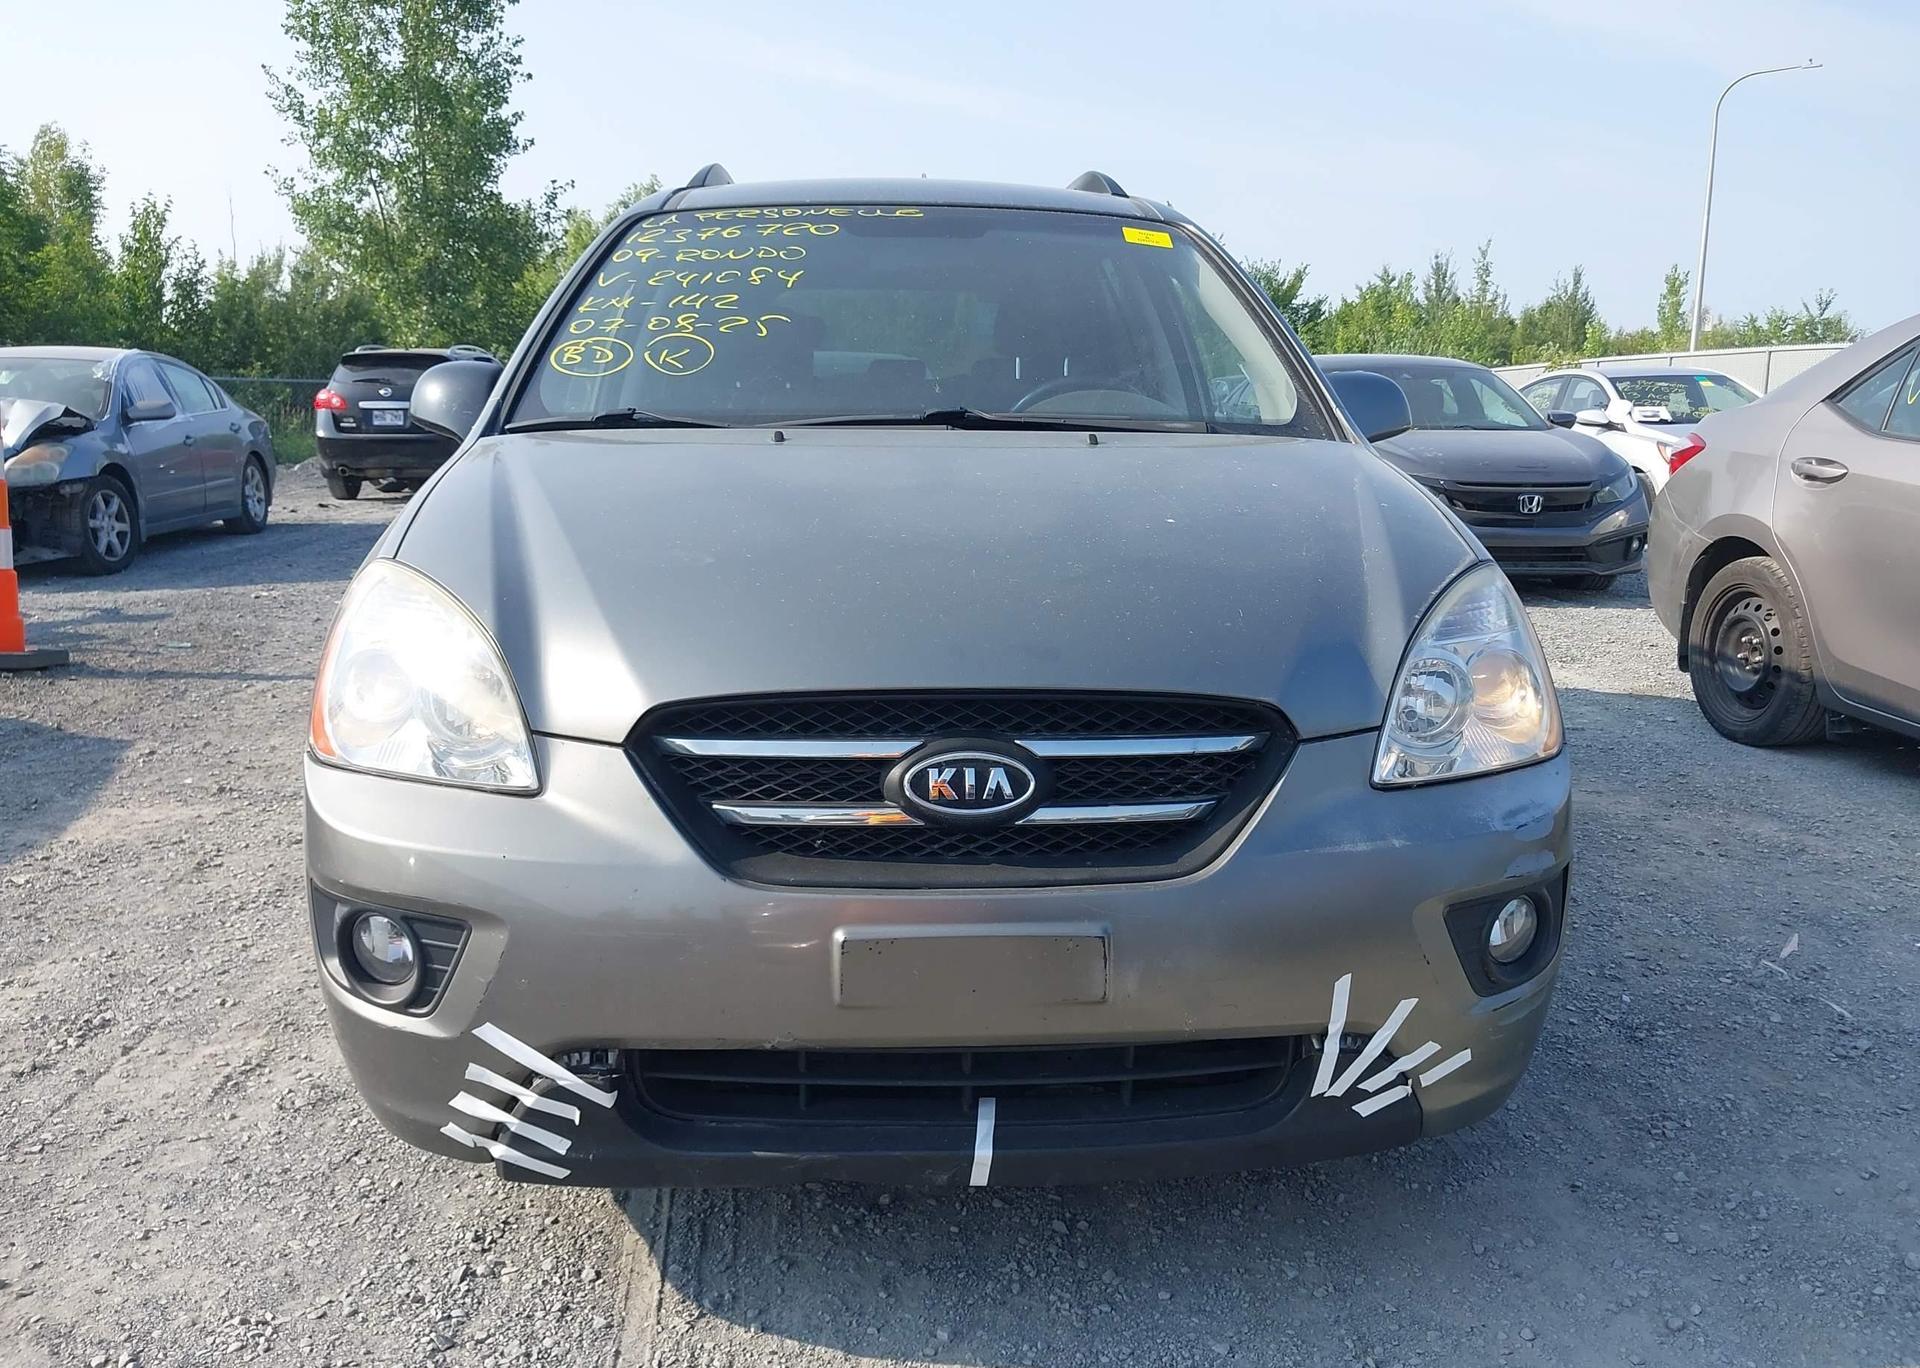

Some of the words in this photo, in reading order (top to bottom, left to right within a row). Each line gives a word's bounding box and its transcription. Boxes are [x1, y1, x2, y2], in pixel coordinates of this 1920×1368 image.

[642, 215, 680, 228] LA
[694, 208, 925, 223] PERSONELLE
[659, 349, 691, 369] K
[926, 767, 1015, 800] KIA
